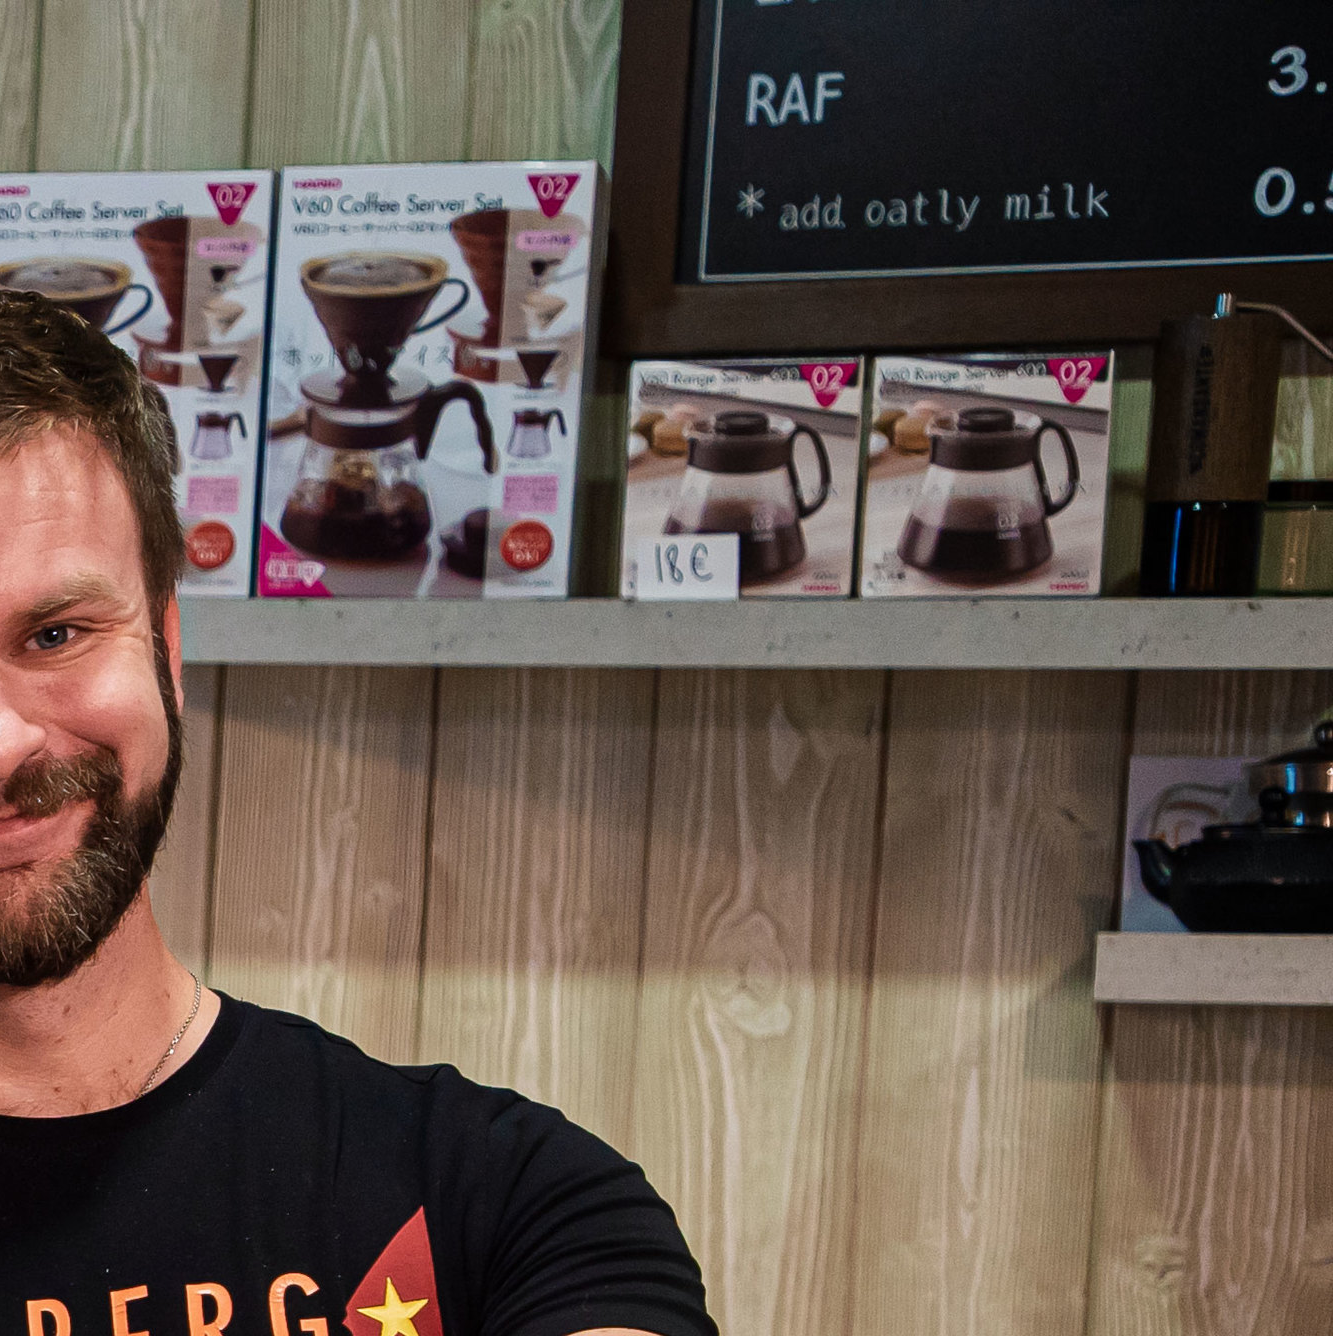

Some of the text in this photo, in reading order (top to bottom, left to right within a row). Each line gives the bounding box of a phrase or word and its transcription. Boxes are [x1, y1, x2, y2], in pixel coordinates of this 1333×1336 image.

[745, 45, 1333, 128] RAF 3.
[215, 184, 247, 209] 02
[537, 175, 569, 200] 02
[779, 166, 1333, 233] add oatly milk 0.
[292, 194, 333, 216] V60
[337, 191, 400, 215] Coffee
[811, 365, 844, 391] 02
[1059, 359, 1093, 386] 02
